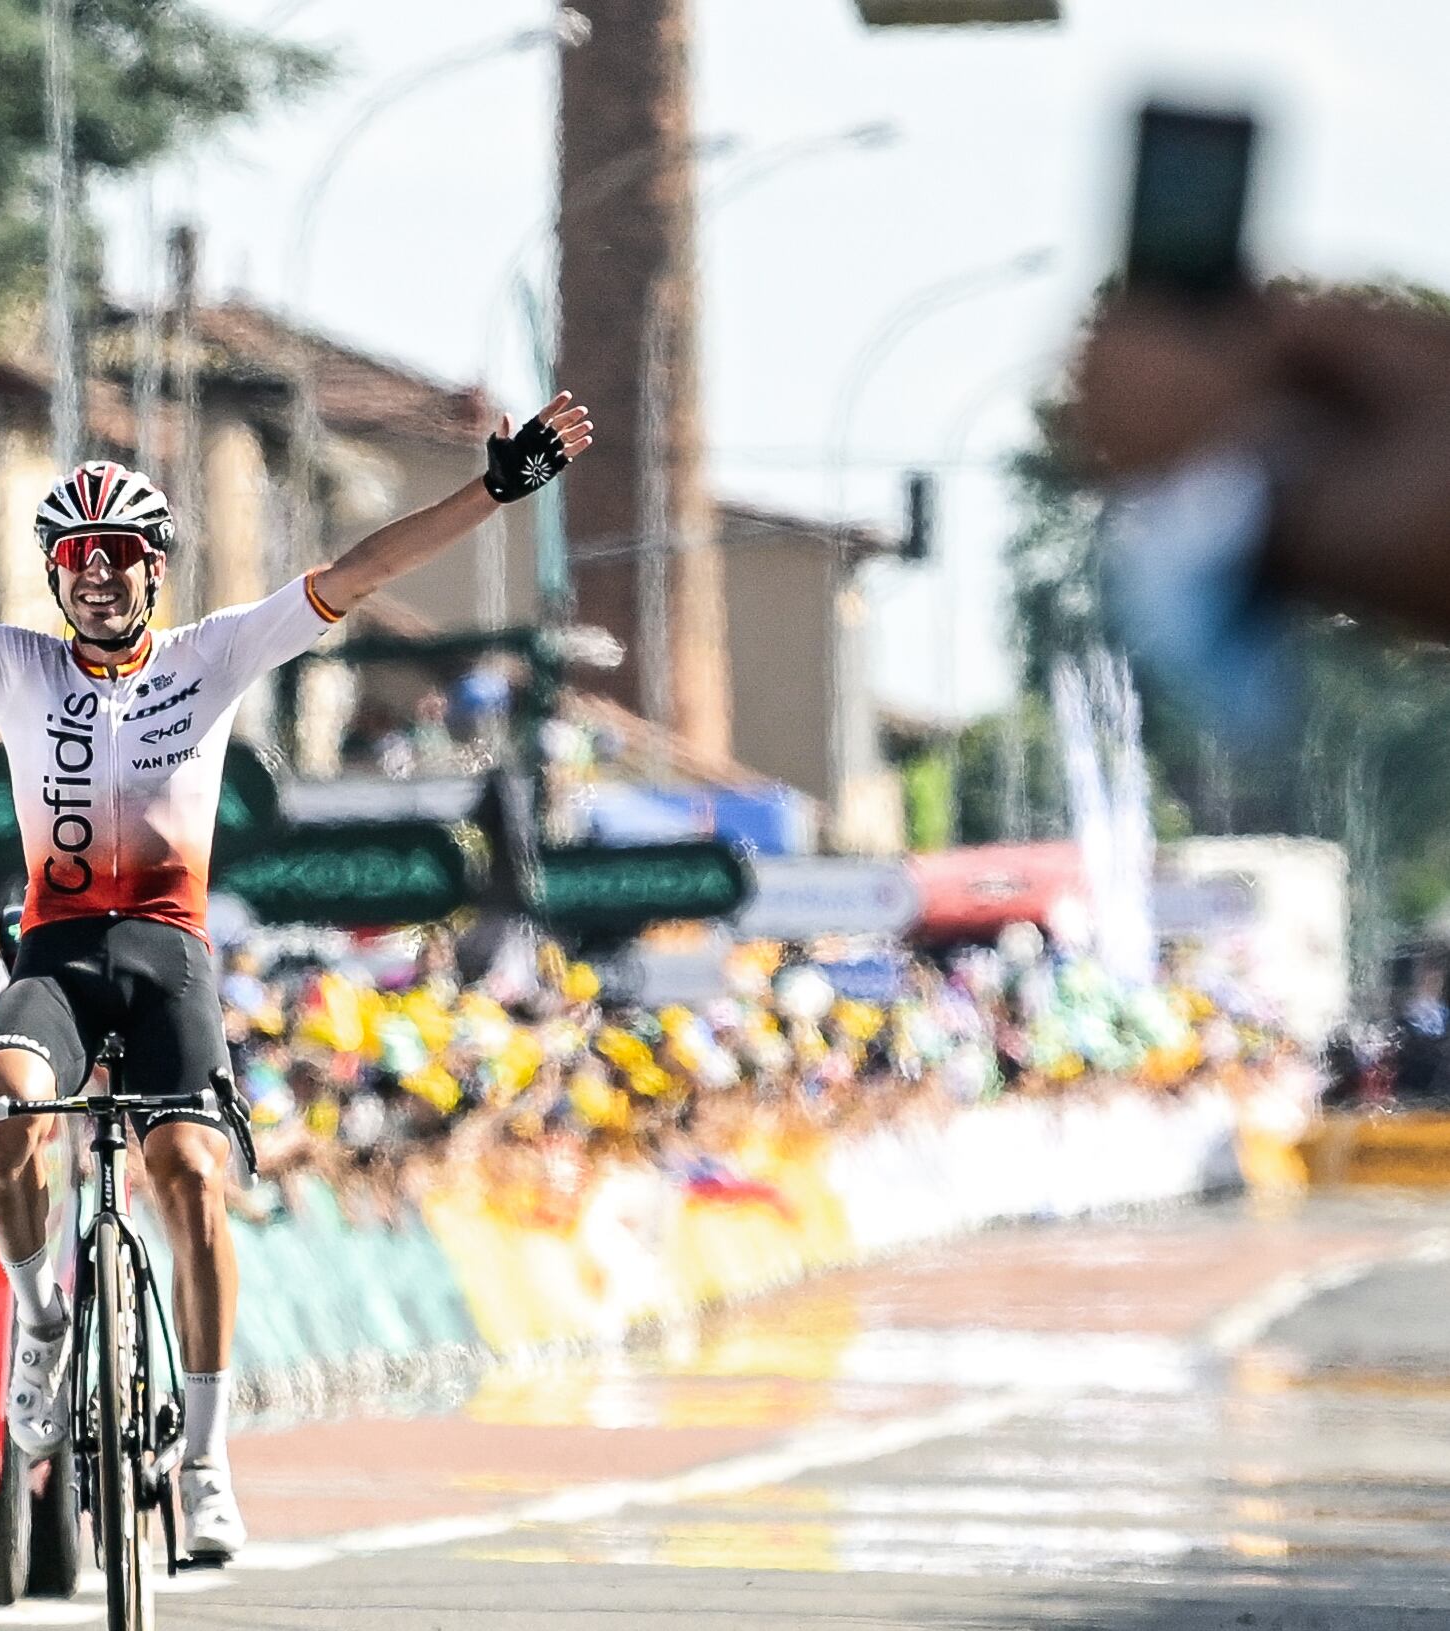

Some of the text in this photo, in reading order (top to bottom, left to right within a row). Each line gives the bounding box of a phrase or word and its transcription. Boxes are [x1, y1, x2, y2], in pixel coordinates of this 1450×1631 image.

[122, 678, 203, 722] LOOK
[131, 744, 202, 770] VAN RYSEL
[42, 690, 99, 897] cofidis
